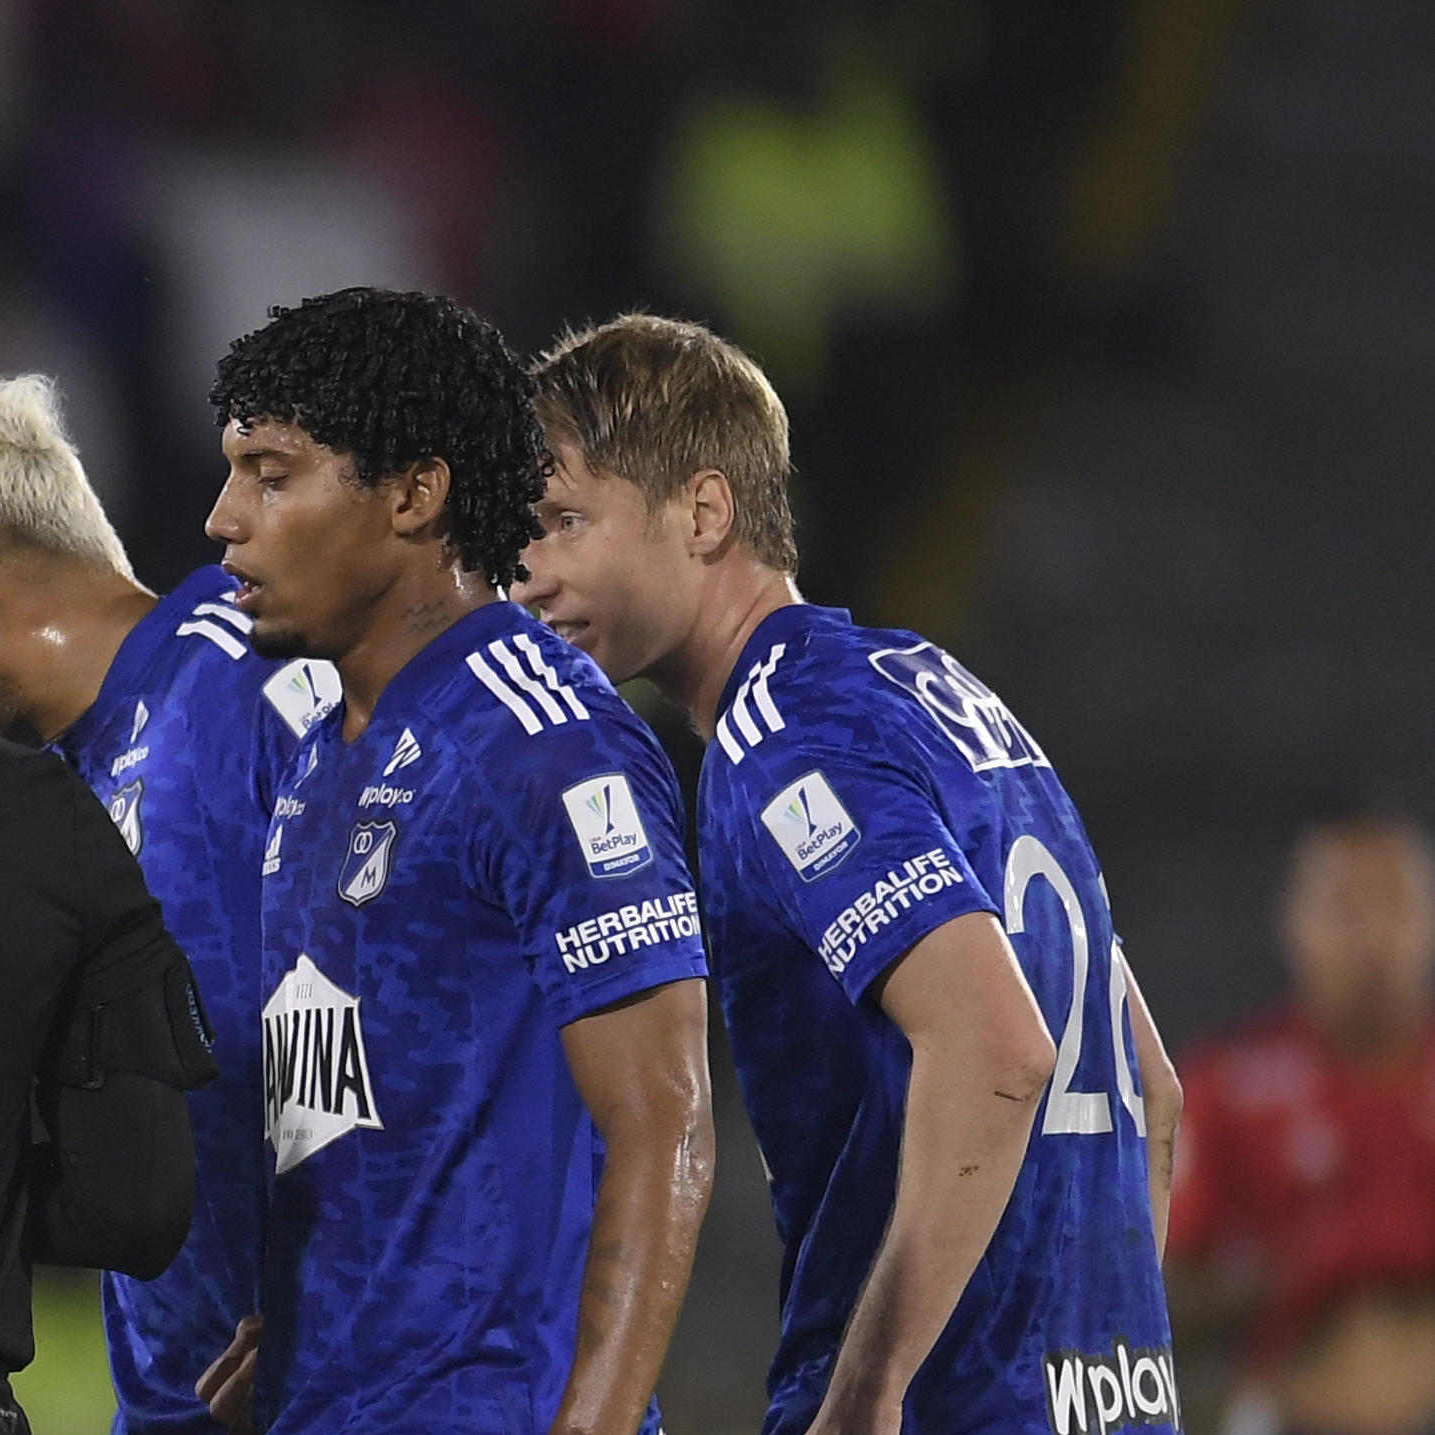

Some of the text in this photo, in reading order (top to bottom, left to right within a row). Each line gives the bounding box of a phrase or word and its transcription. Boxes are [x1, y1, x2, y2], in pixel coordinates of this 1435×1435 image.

[591, 833, 637, 854] BetPlay
[797, 822, 843, 861] BetPlay
[555, 891, 697, 952] HERBALIFE
[818, 848, 950, 963] HERBALIFE
[827, 866, 963, 980] NUTRITION
[562, 913, 700, 973] NUTRITION
